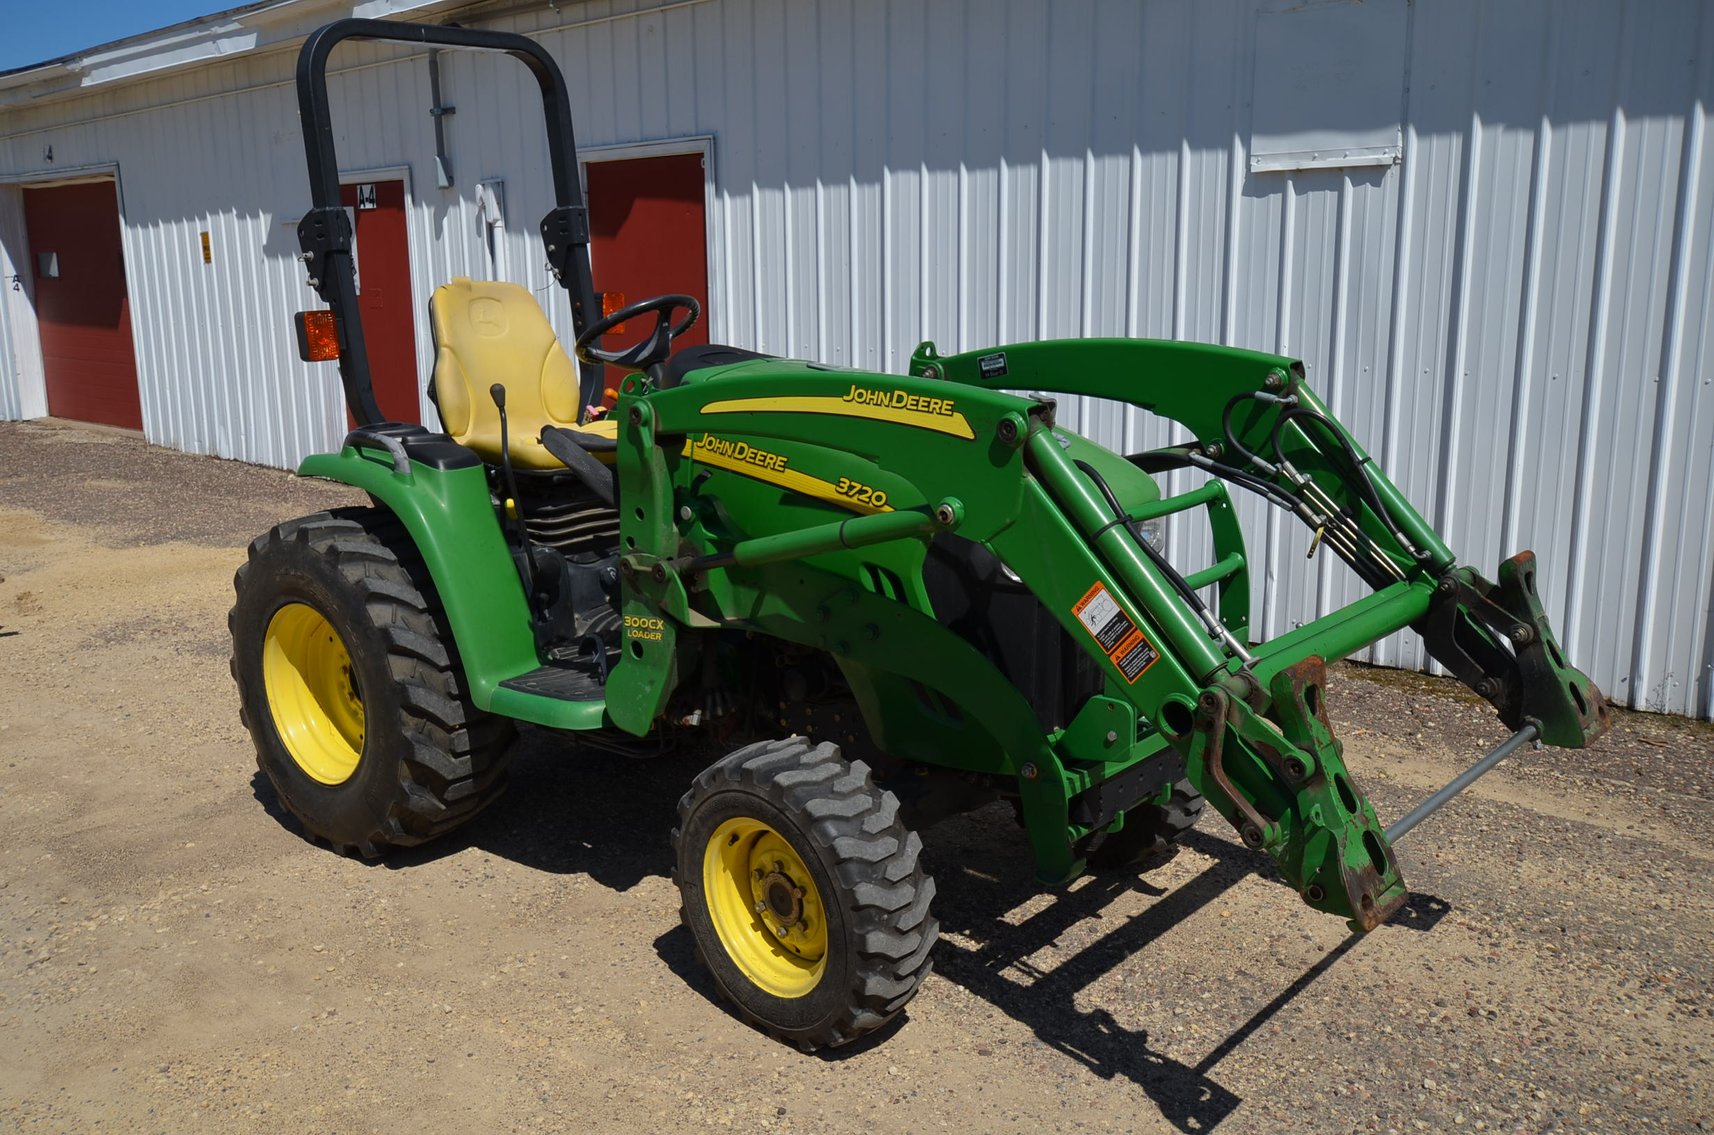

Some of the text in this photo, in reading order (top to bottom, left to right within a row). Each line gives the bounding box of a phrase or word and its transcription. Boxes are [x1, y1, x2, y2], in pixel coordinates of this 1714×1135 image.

[359, 185, 376, 208] A-4
[13, 283, 20, 292] 4
[842, 384, 955, 417] JOHN DEERE
[696, 432, 788, 473] JOHN DEERE
[834, 477, 888, 508] 3720
[1081, 585, 1100, 606] WARNING
[623, 615, 664, 630] 300CX
[627, 629, 662, 641] LOADER
[1119, 634, 1141, 656] WARNING
